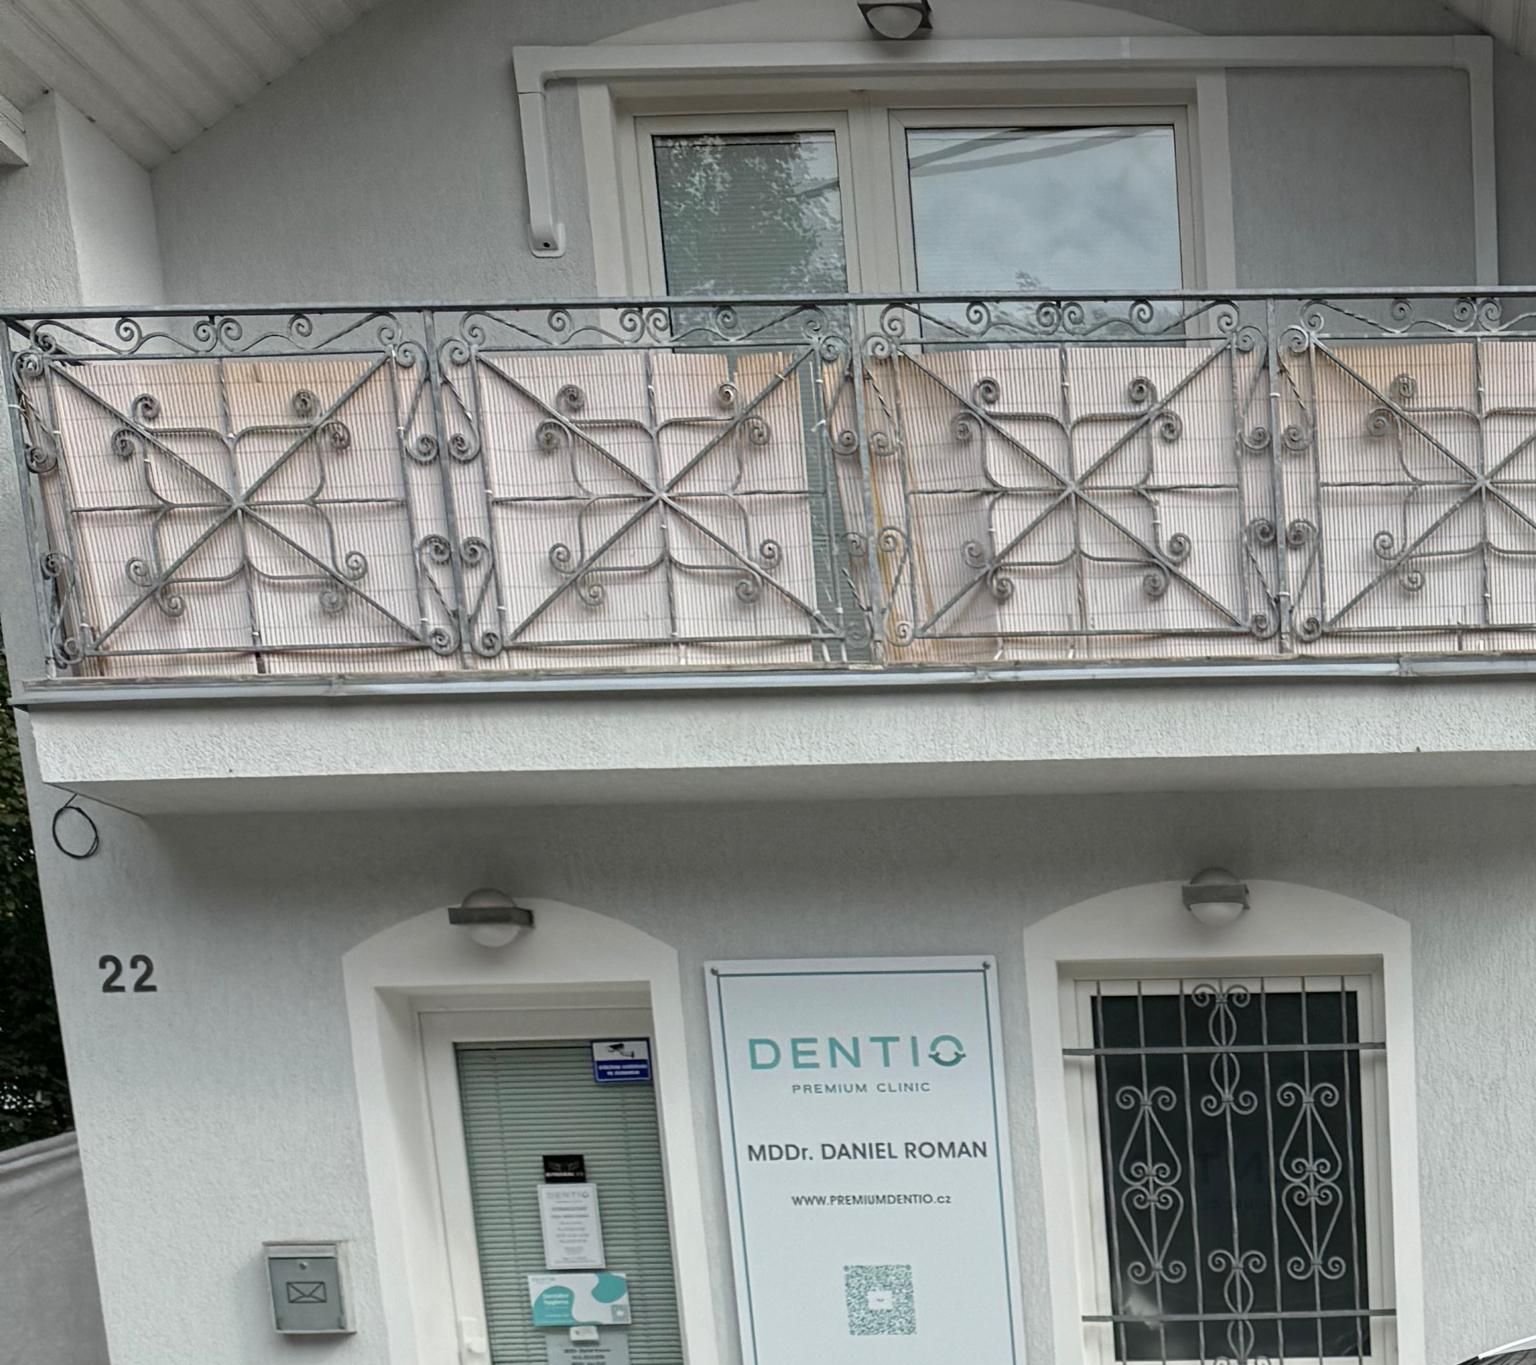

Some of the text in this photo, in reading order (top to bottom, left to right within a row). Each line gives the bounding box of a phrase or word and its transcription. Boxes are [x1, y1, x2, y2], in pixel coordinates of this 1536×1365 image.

[98, 954, 158, 993] 22
[748, 1034, 967, 1070] DENTIO
[791, 1082, 931, 1094] PREMIUM CLINIC
[748, 1141, 988, 1161] MDDr. DANIEL ROMAN
[791, 1193, 952, 1206] WWW.PREMIUMDENTIO.cz
